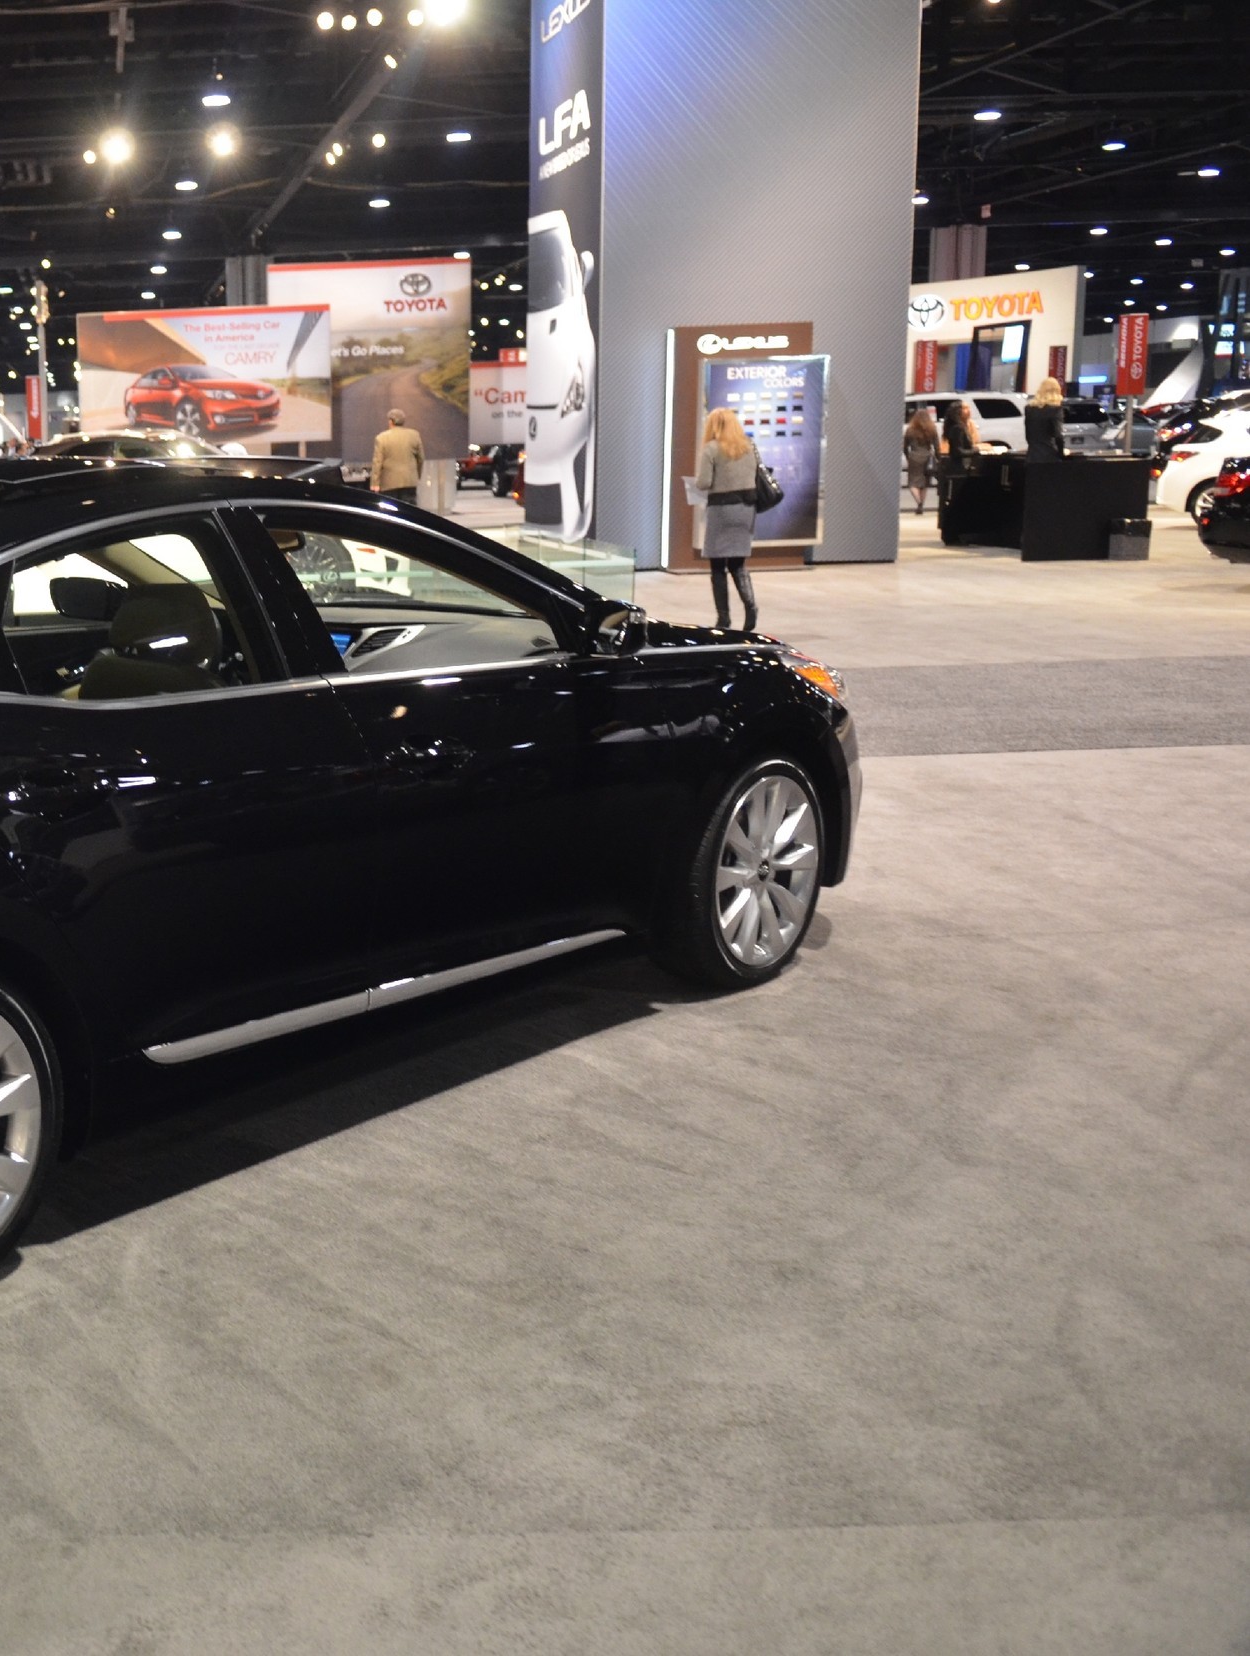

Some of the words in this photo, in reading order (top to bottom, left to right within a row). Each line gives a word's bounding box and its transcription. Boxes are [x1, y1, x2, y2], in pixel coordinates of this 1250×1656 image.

[540, 0, 590, 43] LEXU
[539, 89, 591, 155] LFA
[384, 298, 447, 313] TOYOTA
[951, 290, 1044, 321] TOYOTA
[184, 323, 201, 332] The
[204, 322, 262, 332] Best-Selling
[263, 320, 281, 330] Car
[204, 334, 214, 343] in
[216, 332, 255, 342] America
[1133, 316, 1144, 360] TOYOTA
[331, 346, 350, 357] et's
[352, 346, 367, 356] Go
[369, 345, 405, 356] Places
[225, 352, 276, 365] CAMRY
[924, 341, 934, 377] TOYOTA
[727, 366, 787, 379] EXTERIOR
[763, 377, 805, 388] COLORS
[507, 410, 523, 418] the
